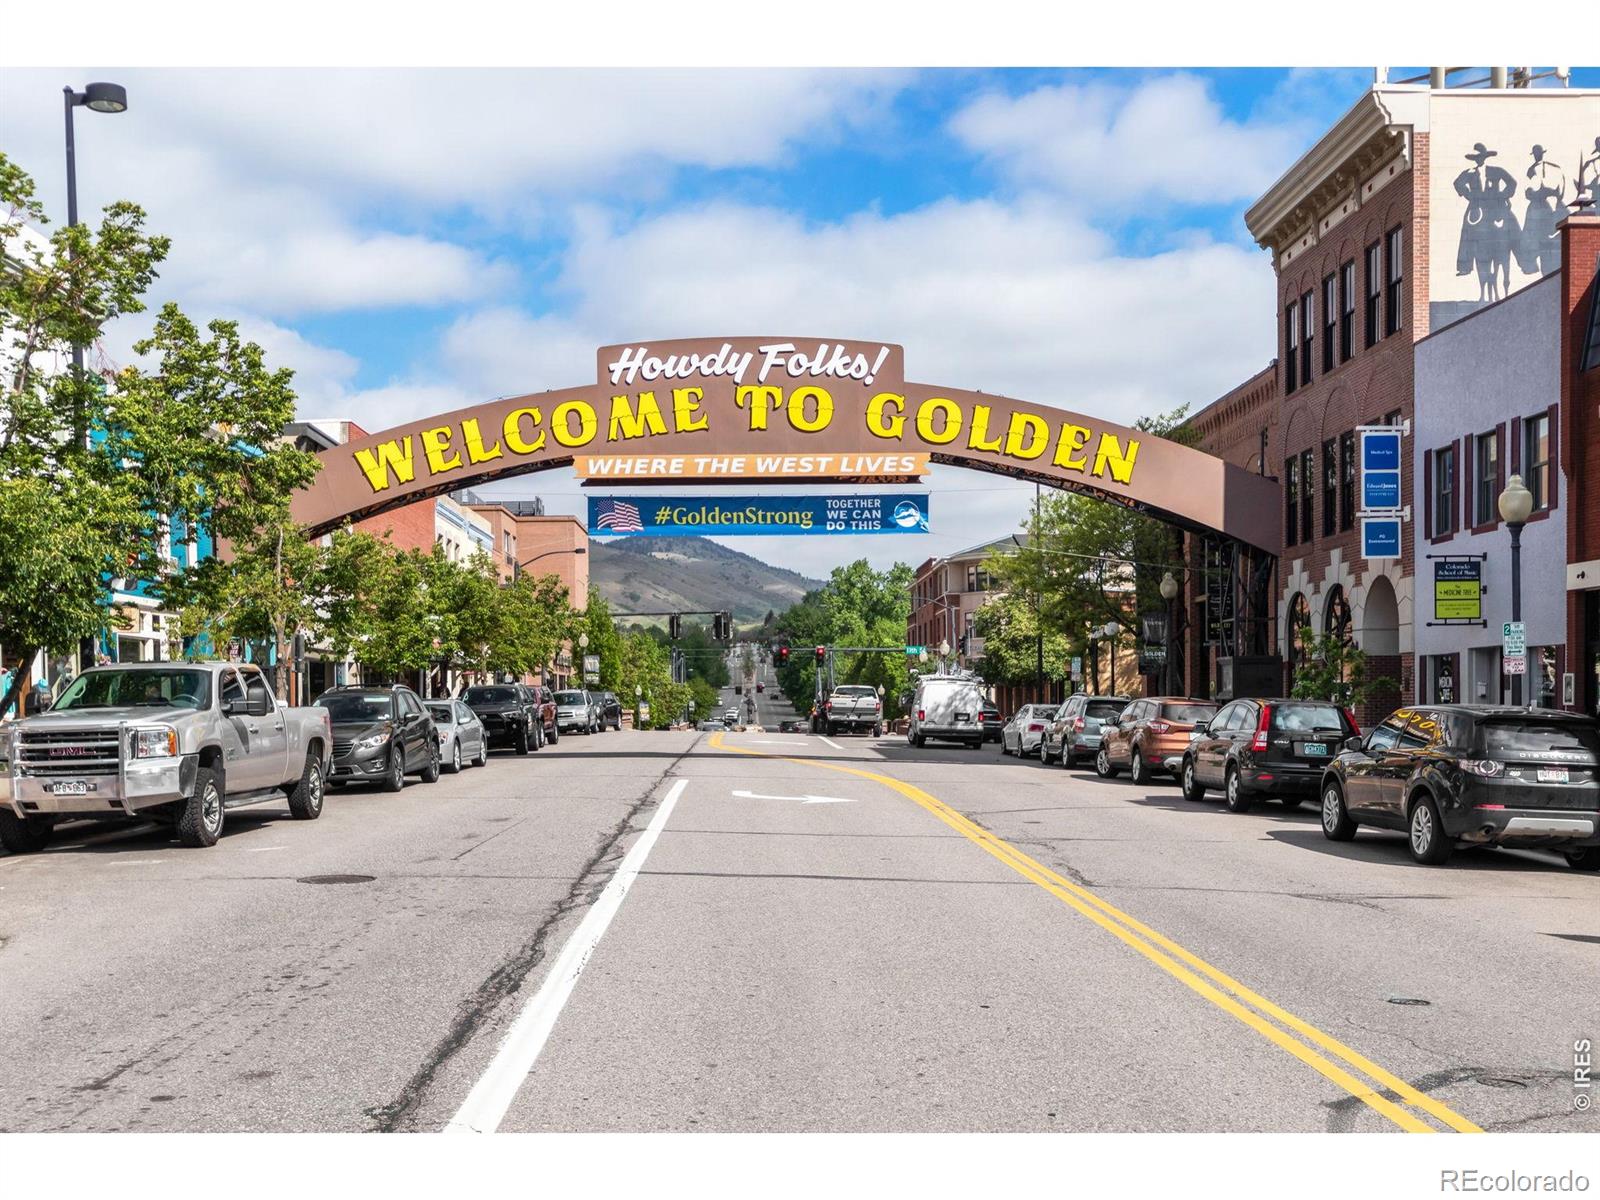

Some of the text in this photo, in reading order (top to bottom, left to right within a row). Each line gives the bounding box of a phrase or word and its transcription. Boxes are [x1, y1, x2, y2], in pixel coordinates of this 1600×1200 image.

[608, 342, 890, 386] Howdy Folks!
[353, 385, 1140, 492] WELCOME TO GOLDEN
[587, 456, 916, 475] WHERE THE WEST LIVES
[826, 499, 881, 508] TOGETHER
[654, 504, 813, 528] #GoldenStrong
[827, 509, 881, 519] WE CAN
[826, 520, 881, 530] DO THIS
[1504, 624, 1510, 635] 2
[49, 746, 97, 756] GMC
